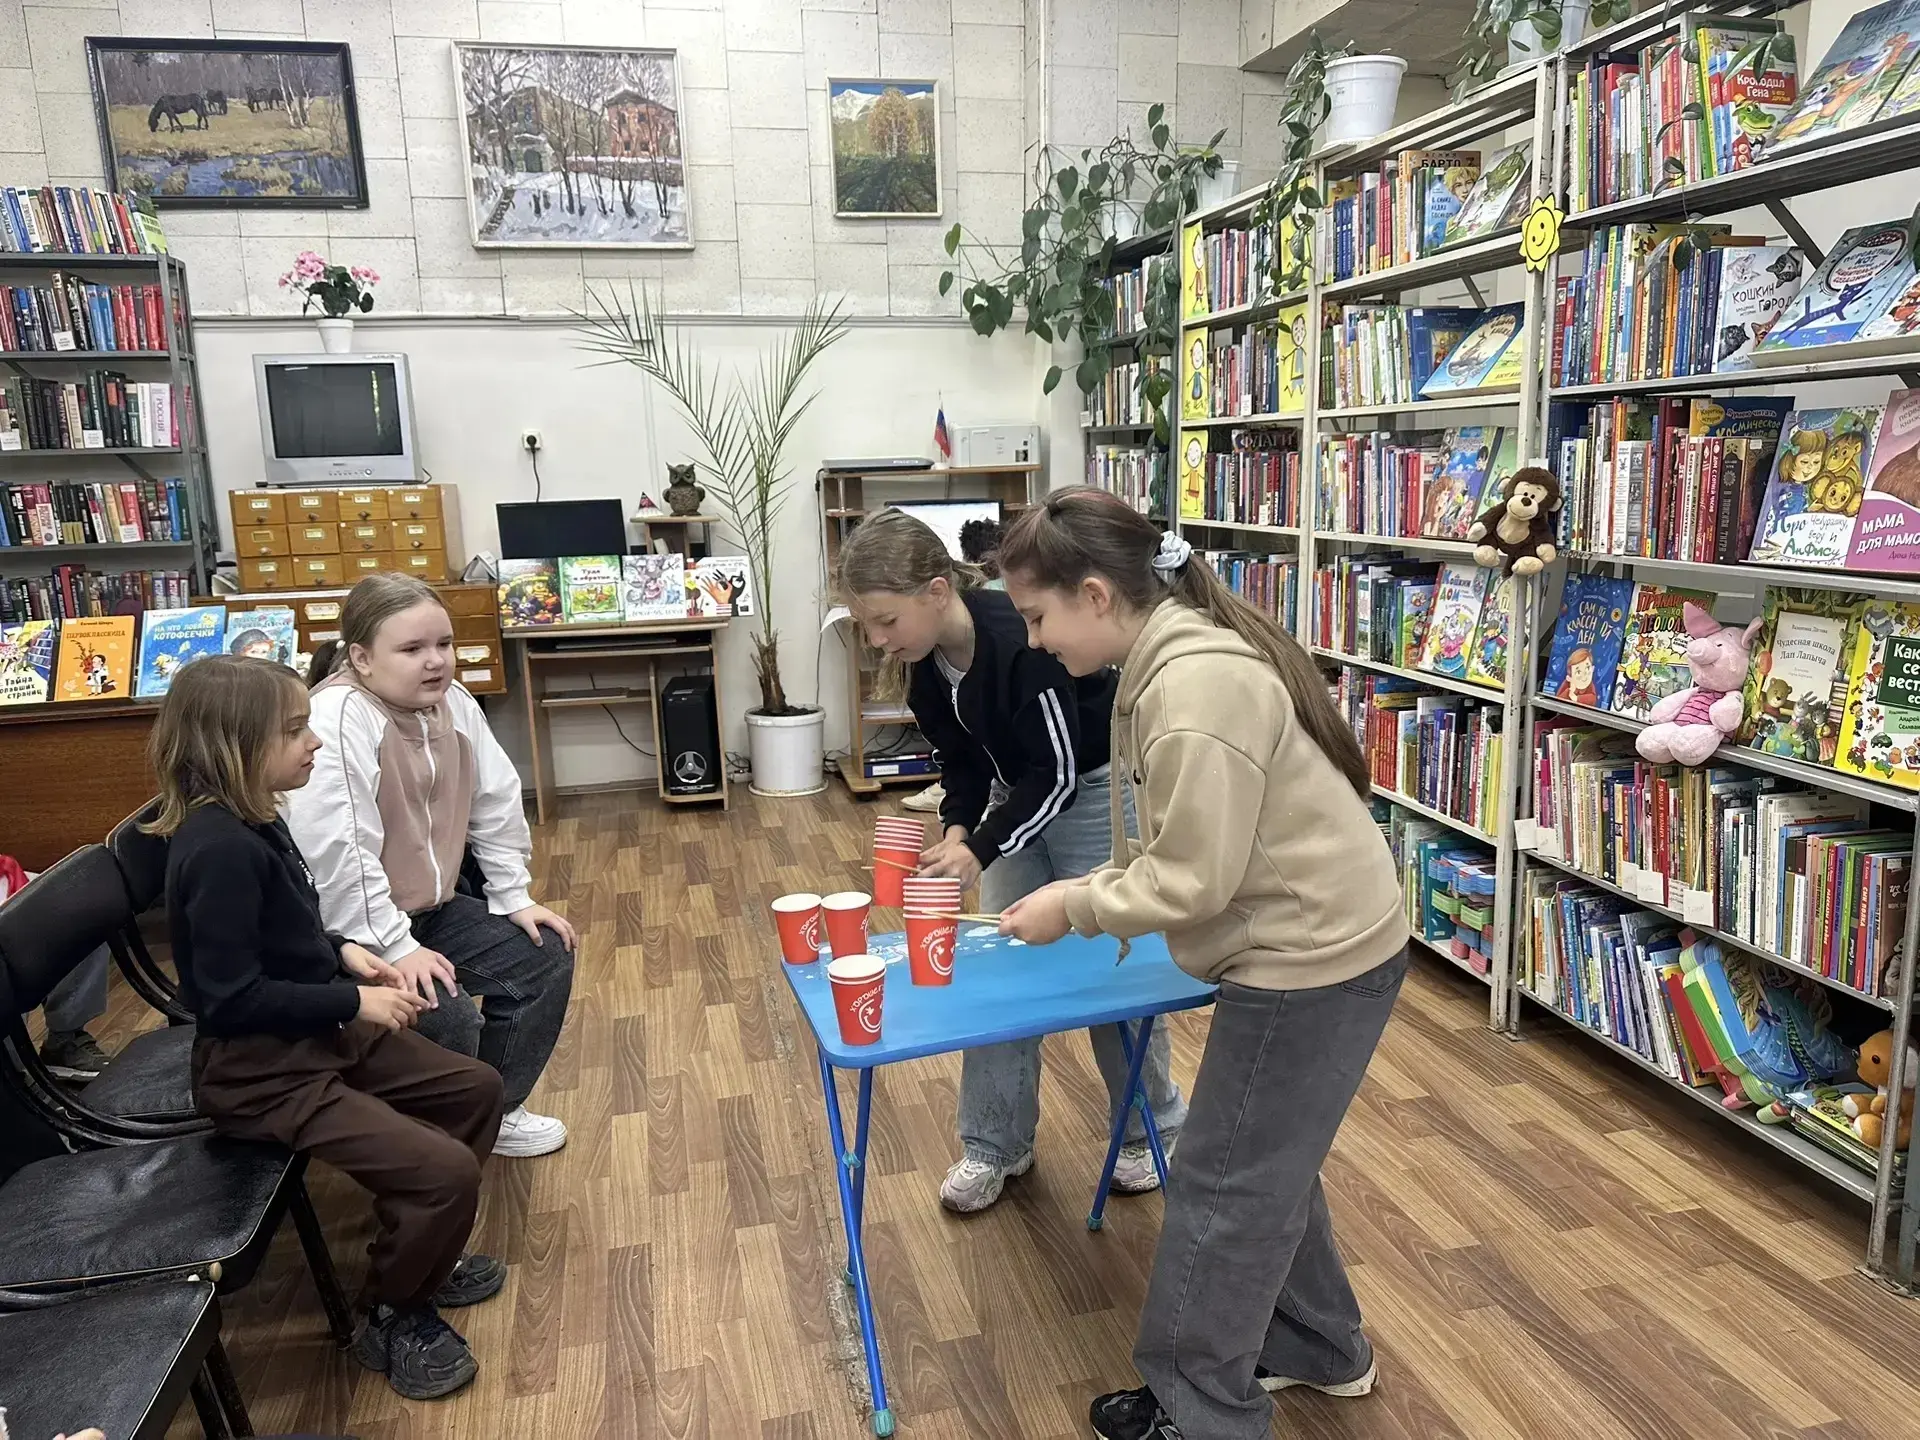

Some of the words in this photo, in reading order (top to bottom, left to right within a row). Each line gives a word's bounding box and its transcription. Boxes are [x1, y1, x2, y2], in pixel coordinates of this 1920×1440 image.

[1736, 74, 1785, 88] Кроодил
[1746, 86, 1769, 98] Гена
[1421, 158, 1460, 167] БАРТО
[1732, 283, 1774, 304] КОШКИН
[1759, 296, 1793, 312] ГОРОД
[156, 397, 165, 432] РОССИЯ
[1774, 510, 1807, 536] Про
[1861, 512, 1905, 534] МАМА
[1856, 537, 1882, 555] ДЛЯ
[66, 630, 125, 639] ПЕРВОКЛАССНИЦА
[153, 630, 215, 641] КОТОФЕЕЧКИ
[167, 624, 181, 632] ЧТО
[1776, 638, 1811, 648] Чудесная
[1812, 641, 1836, 655] школа
[1894, 643, 1920, 660] Как
[1780, 650, 1795, 660] Лап
[1796, 651, 1827, 666] Лапыча
[5, 676, 33, 686] Тайна
[7, 689, 42, 699] страниц
[1859, 903, 1867, 927] ПОЛКА
